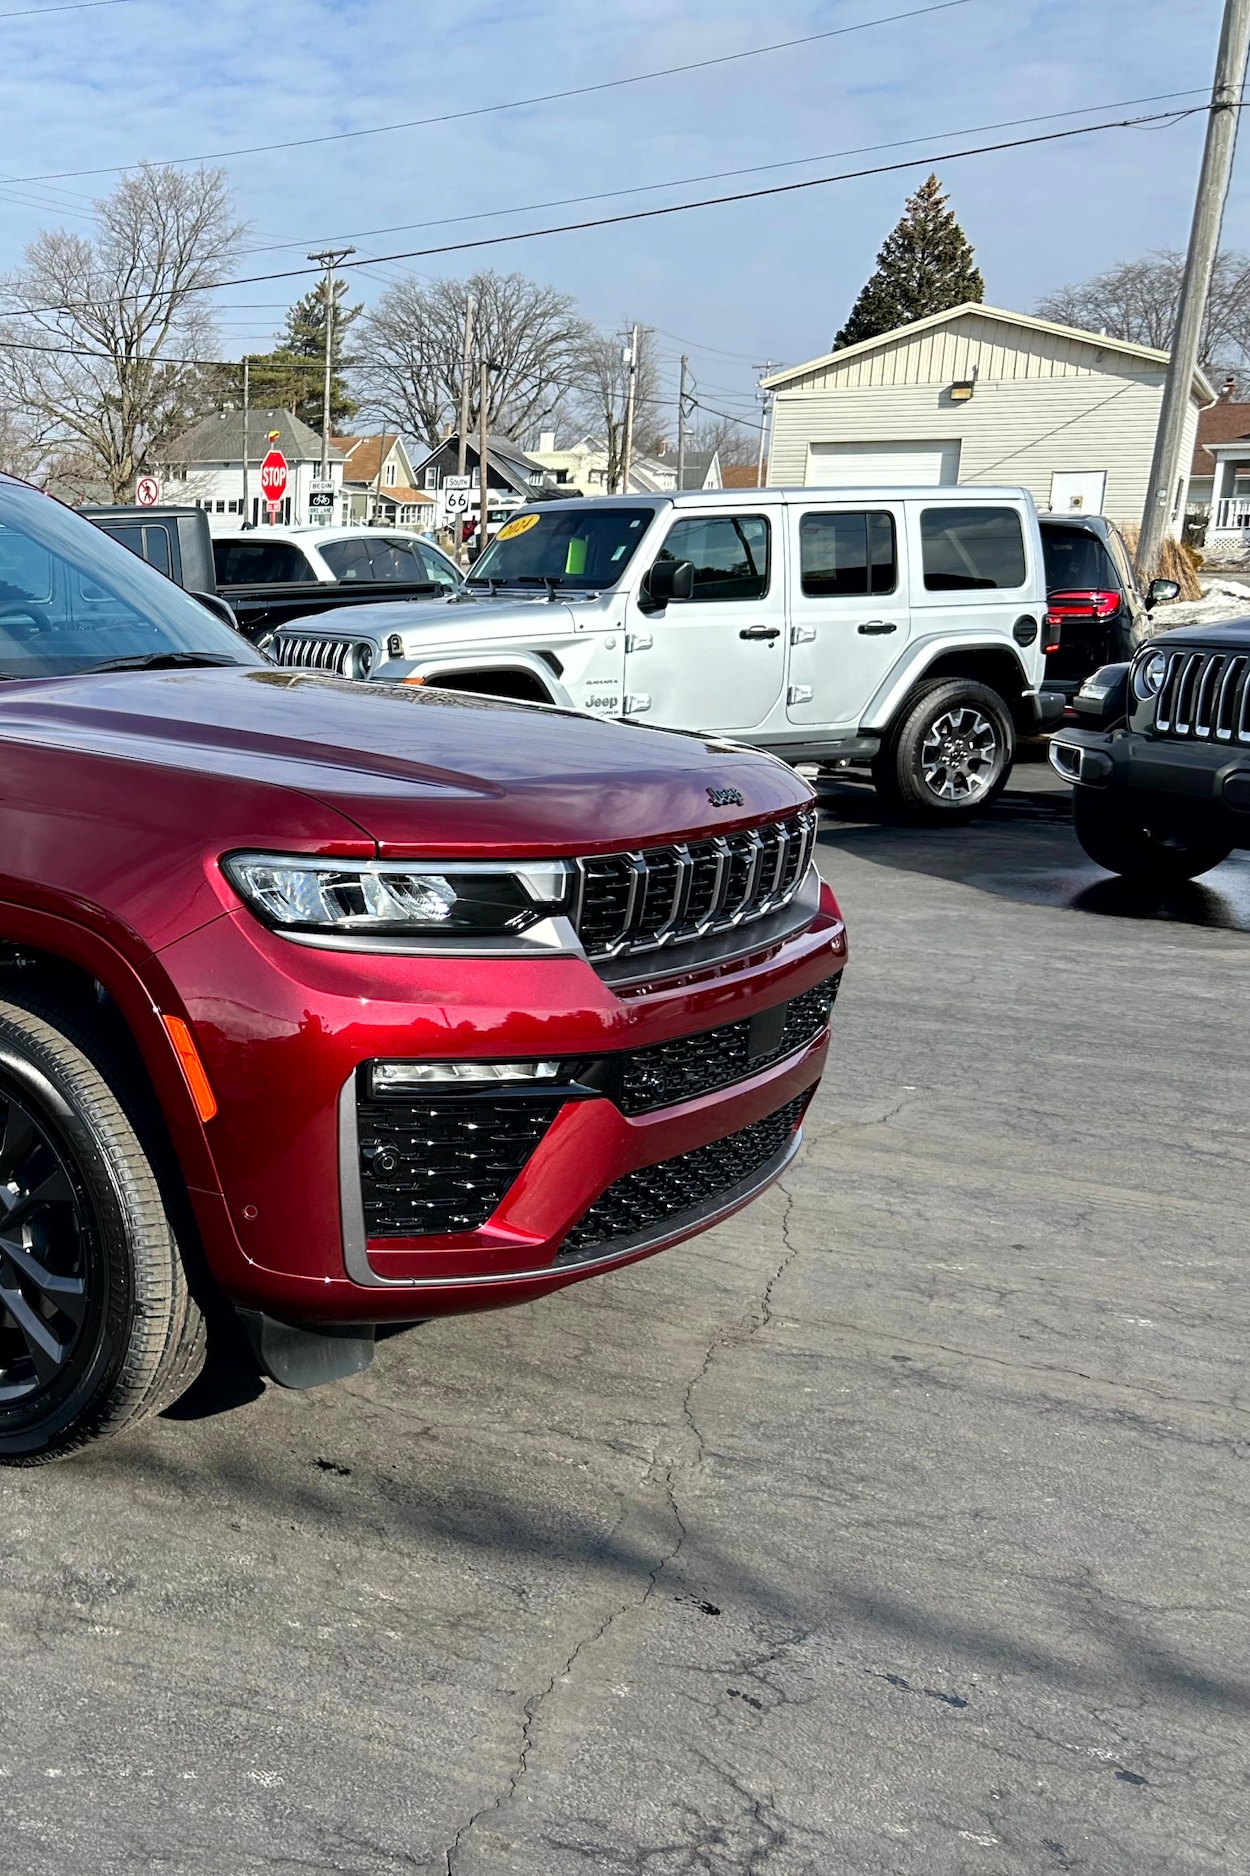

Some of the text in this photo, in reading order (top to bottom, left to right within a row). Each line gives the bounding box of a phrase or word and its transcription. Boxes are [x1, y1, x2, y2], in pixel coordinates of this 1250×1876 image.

[262, 467, 286, 487] STOP
[449, 478, 468, 486] SOUTH
[448, 493, 466, 507] 66
[585, 695, 618, 709] Jeep
